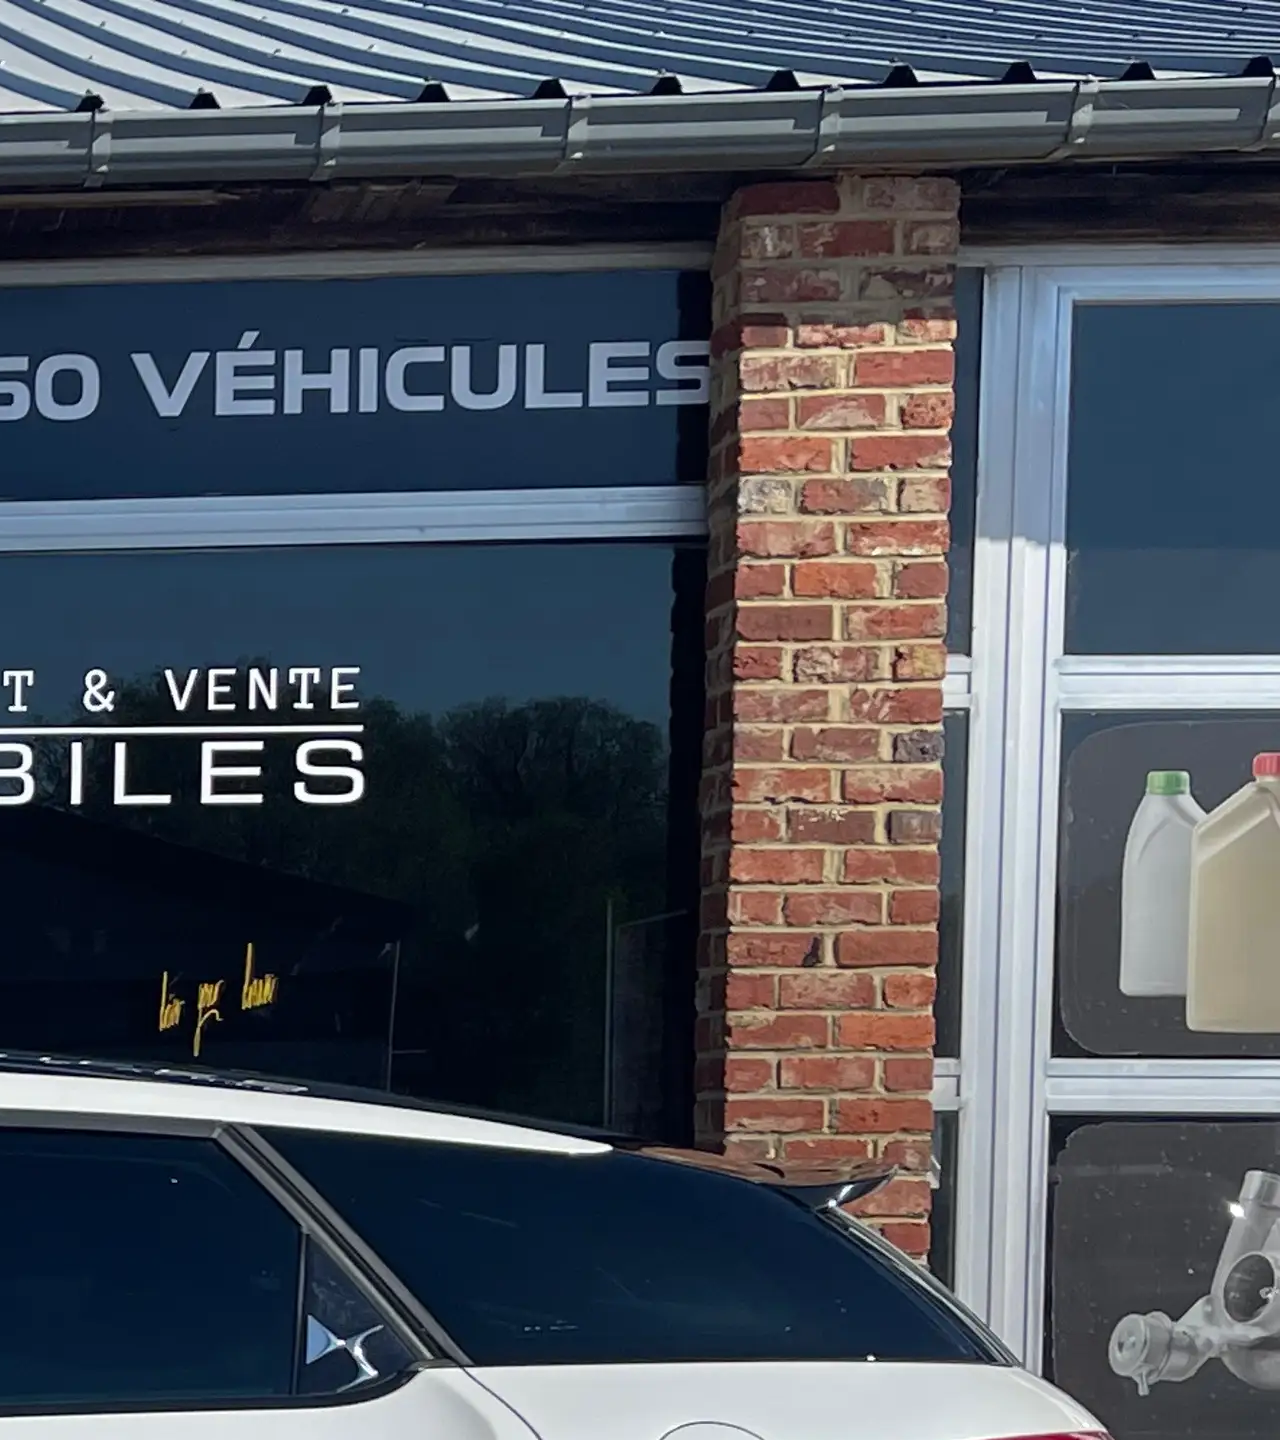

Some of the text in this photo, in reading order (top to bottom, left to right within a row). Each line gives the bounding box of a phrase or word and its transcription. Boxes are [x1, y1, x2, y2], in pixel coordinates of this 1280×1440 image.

[131, 330, 710, 418] VÉHICULES
[82, 669, 116, 713] &
[164, 666, 362, 711] VENTE
